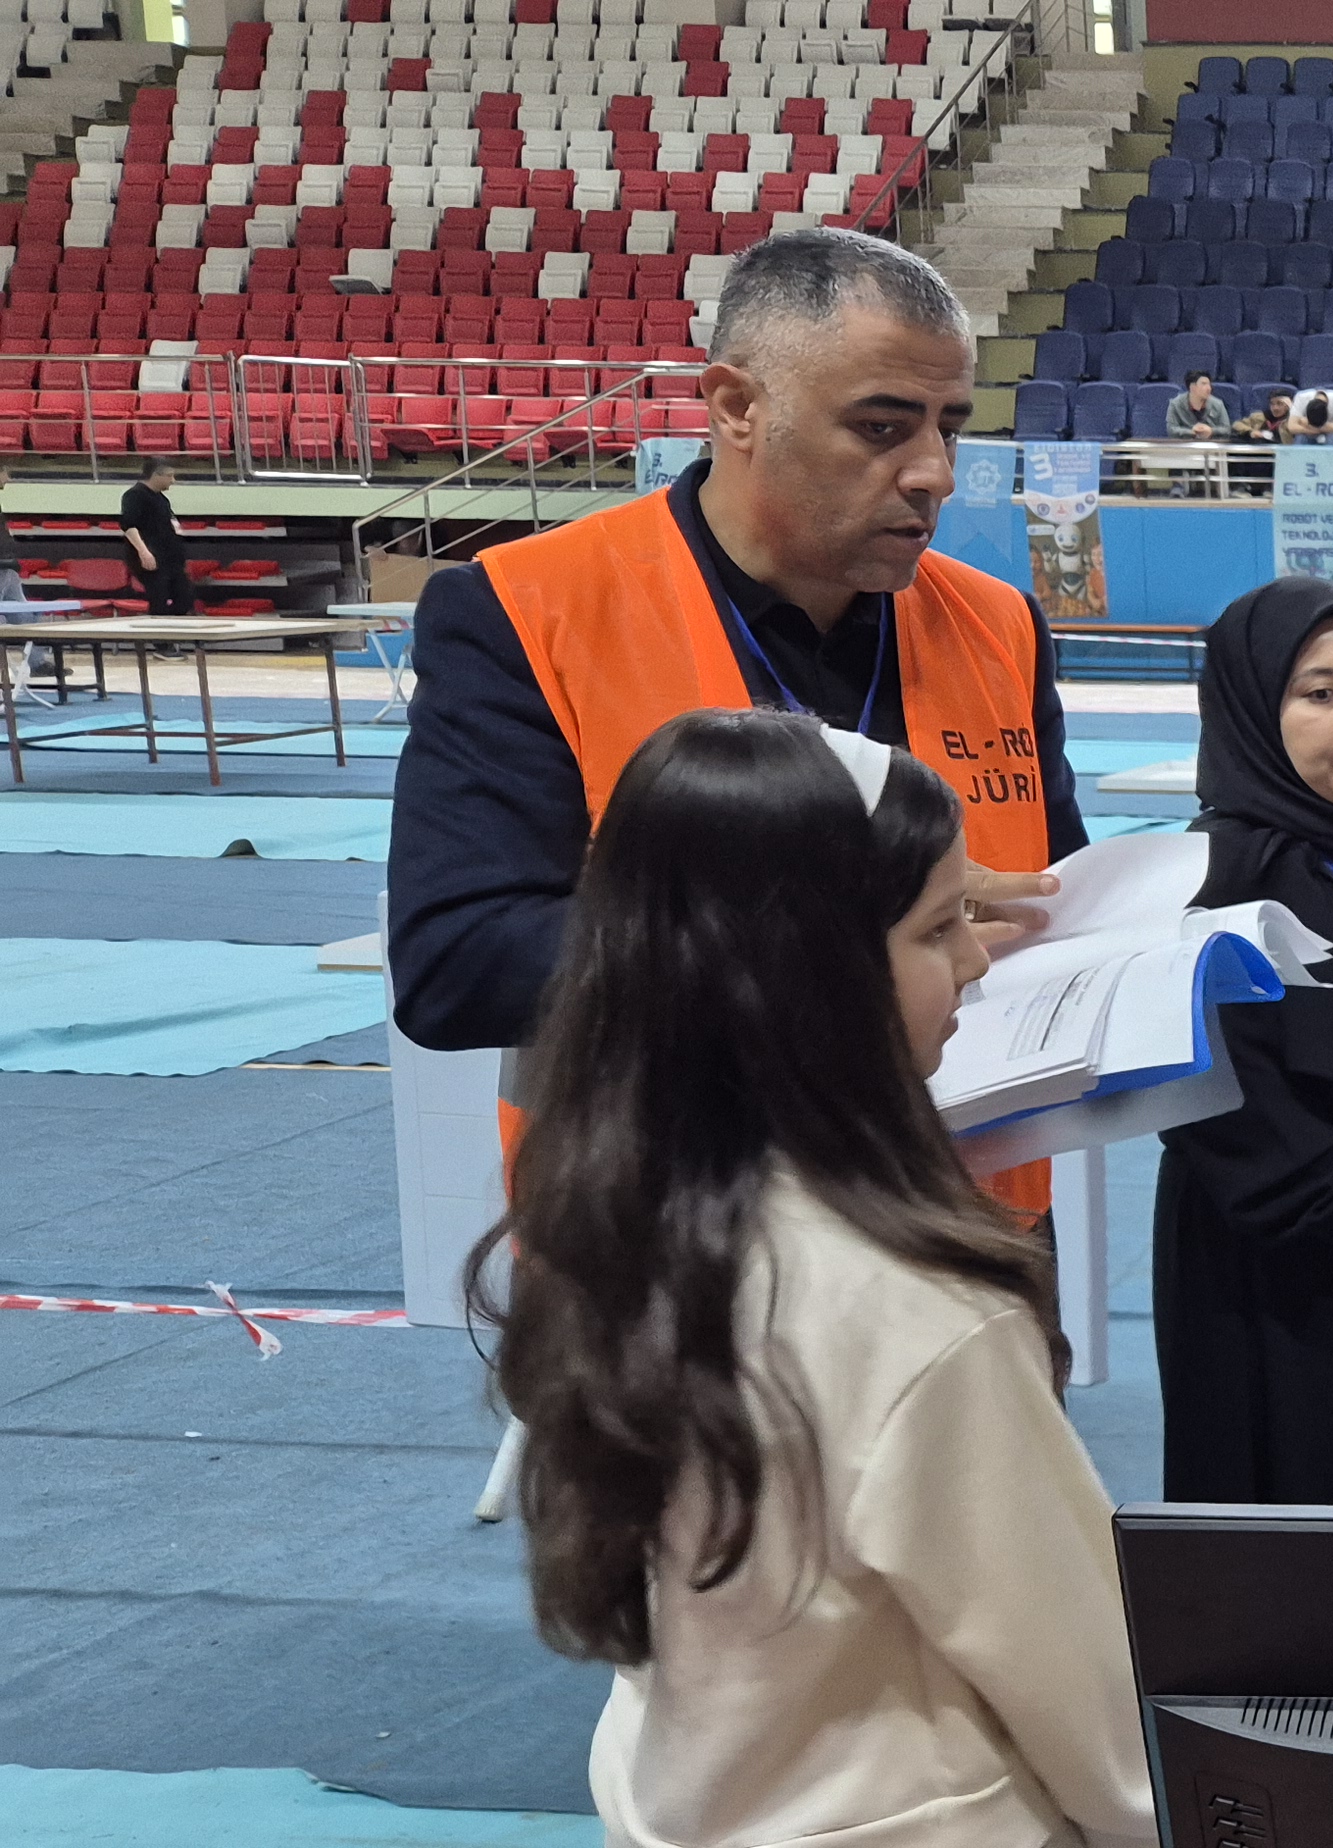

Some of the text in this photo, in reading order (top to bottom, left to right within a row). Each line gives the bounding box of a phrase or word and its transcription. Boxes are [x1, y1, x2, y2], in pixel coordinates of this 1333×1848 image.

[1305, 462, 1319, 478] 3.
[1282, 482, 1302, 496] EL
[941, 729, 979, 760] EL
[966, 765, 1037, 804] JÜRİ
